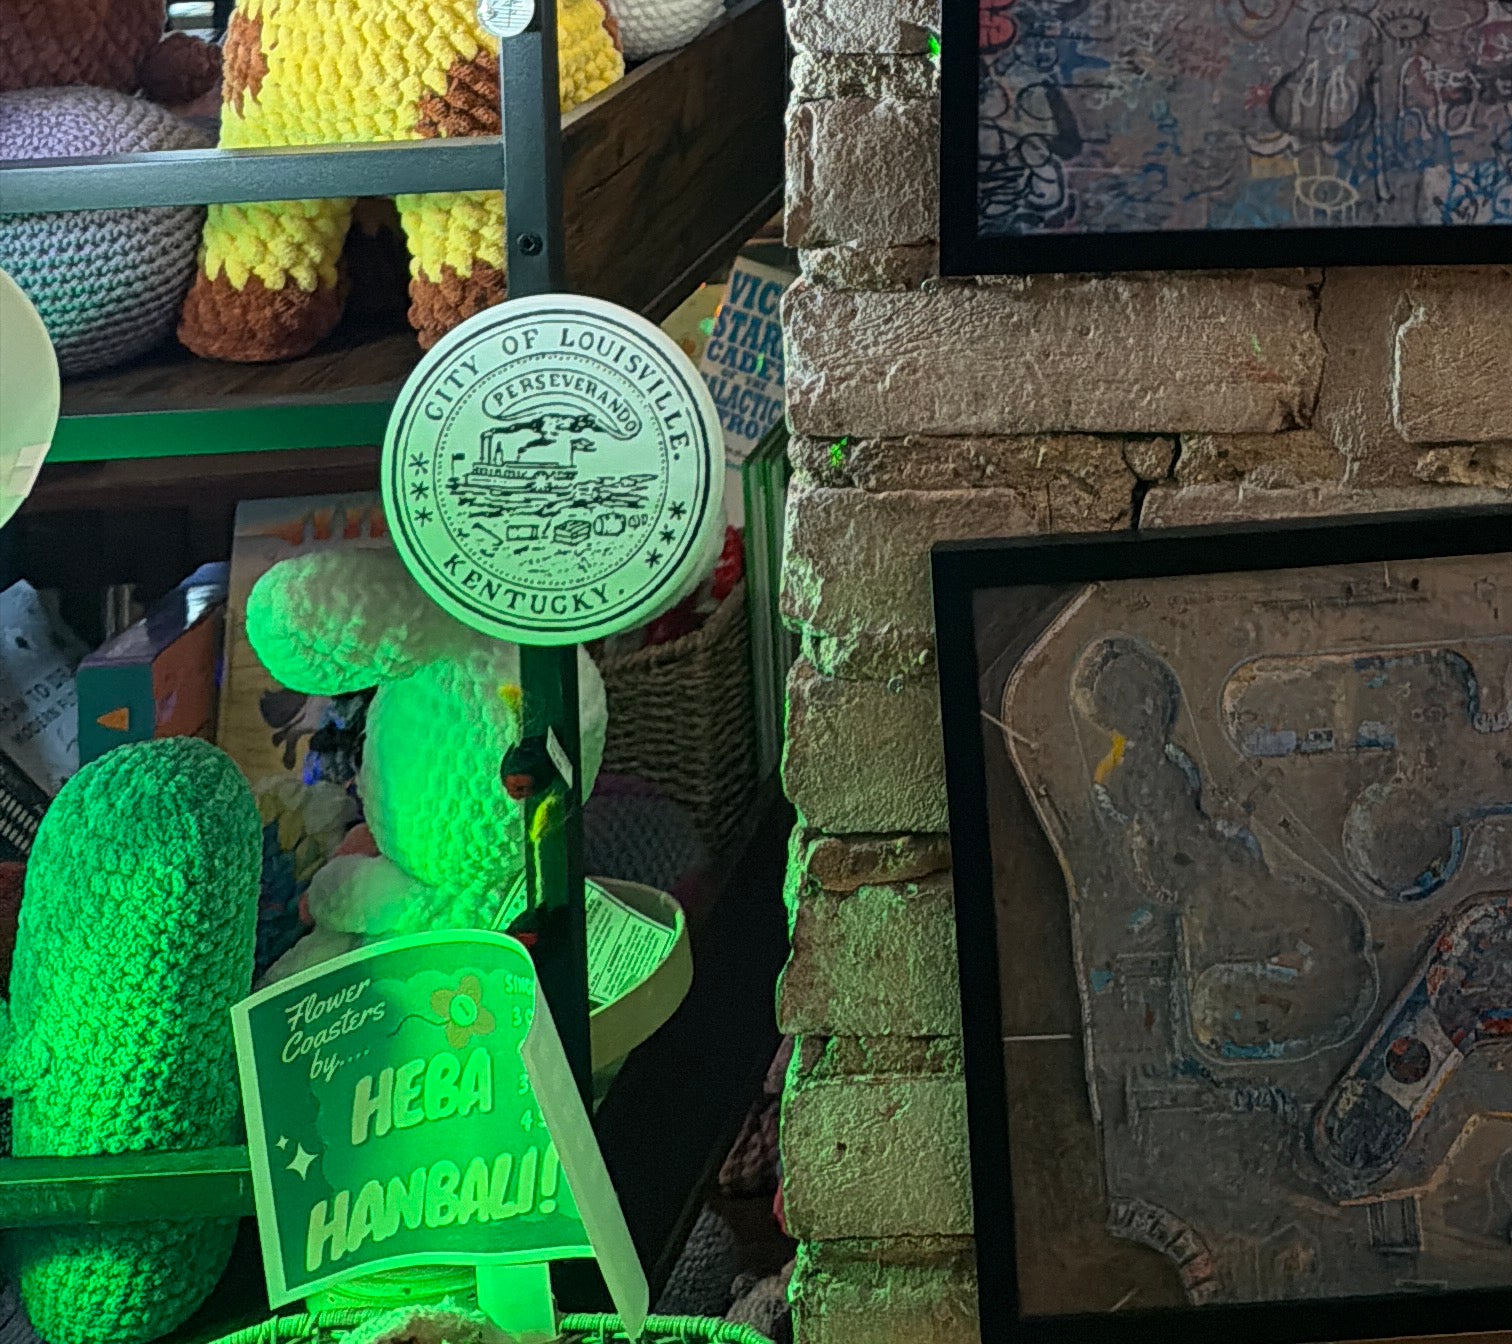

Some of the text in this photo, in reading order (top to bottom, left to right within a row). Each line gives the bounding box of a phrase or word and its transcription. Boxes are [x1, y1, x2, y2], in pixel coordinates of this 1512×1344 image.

[424, 355, 480, 422] CITY
[501, 327, 539, 355] OF
[493, 373, 637, 433] PERSEVERANDO
[281, 1001, 387, 1064] Coasters
[285, 978, 371, 1032] Flower
[350, 1045, 493, 1146] HEBA
[305, 1143, 561, 1273] HANBALI!
